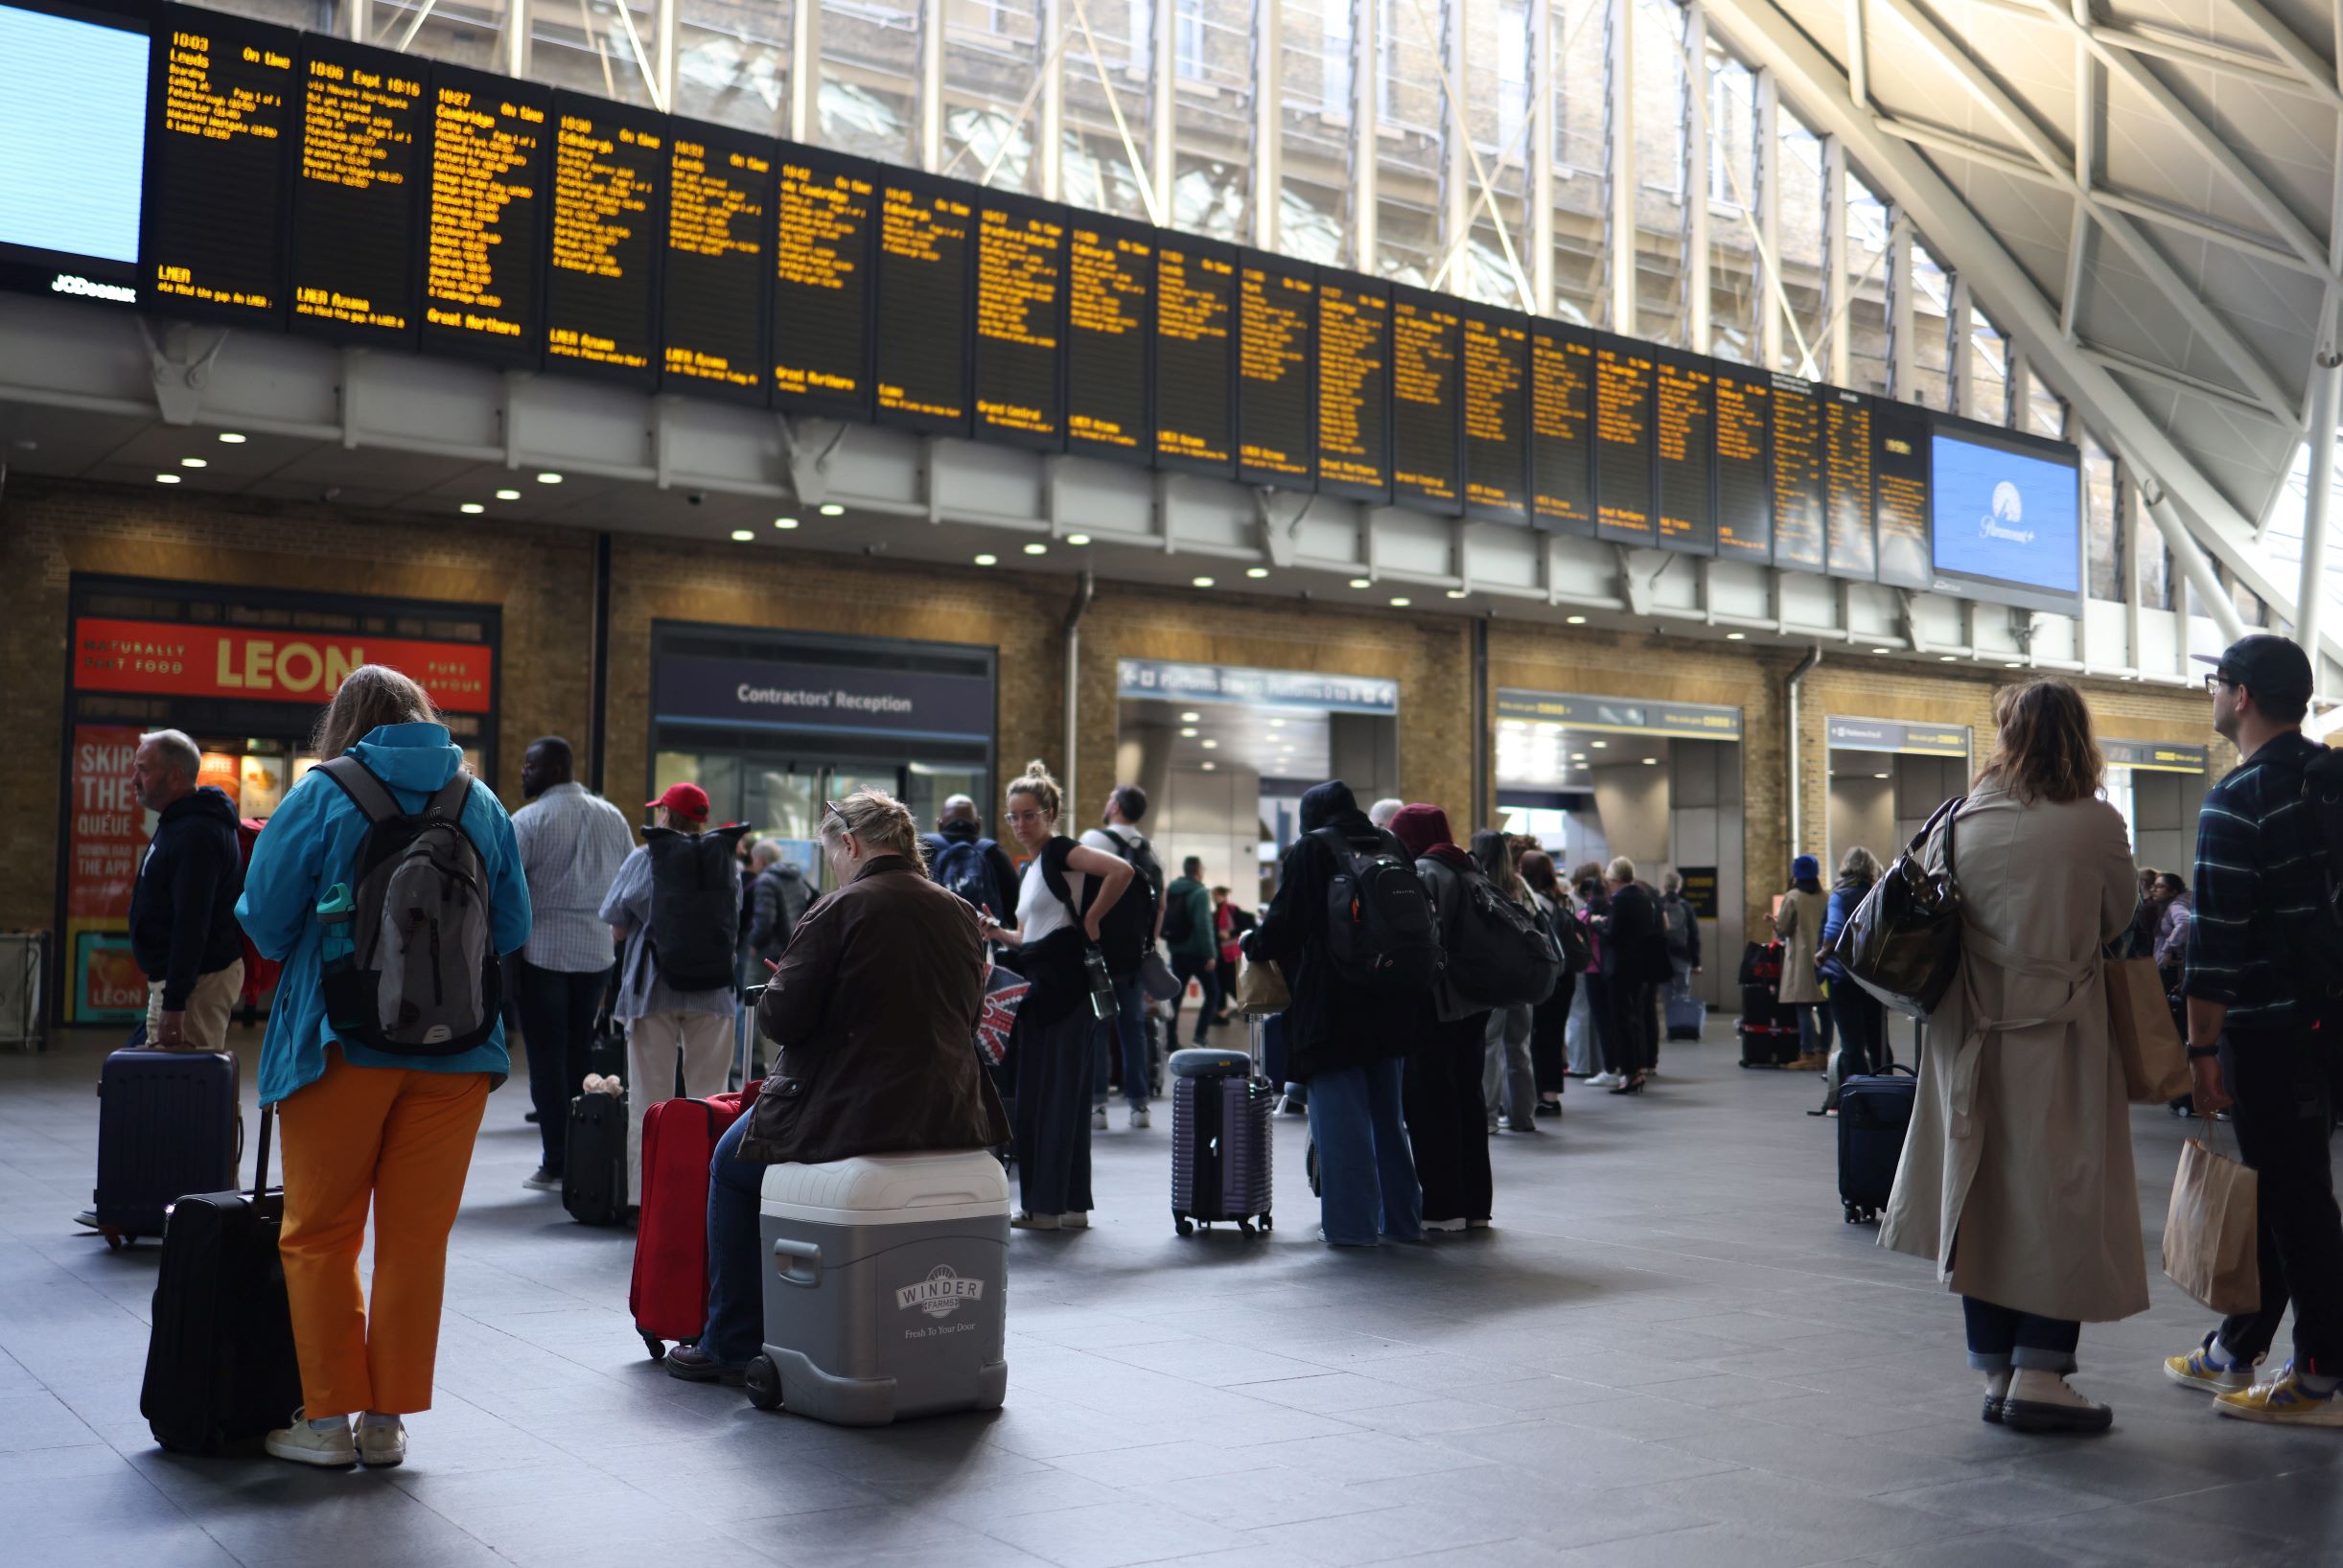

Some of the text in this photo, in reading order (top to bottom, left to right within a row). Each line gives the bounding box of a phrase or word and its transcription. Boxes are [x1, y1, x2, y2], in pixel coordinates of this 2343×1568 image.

[174, 31, 208, 52] 10:03
[170, 48, 209, 68] Leeds
[244, 47, 290, 69] On time
[311, 60, 343, 81] 10:06
[436, 104, 495, 128] Cambridge
[500, 102, 544, 123] On time
[157, 265, 191, 283] LNER
[428, 308, 521, 335] Great Northern
[84, 639, 186, 657] NATURALLY
[135, 658, 183, 675] FOOD
[217, 637, 365, 692] LEON
[429, 661, 467, 676] PURE
[1160, 674, 1218, 691] Platforms
[737, 684, 912, 713] Contractors' Reception
[81, 744, 134, 773] SKIP
[81, 777, 132, 810] THE
[78, 815, 131, 837] QUEUE
[78, 858, 128, 876] THE APP
[93, 989, 142, 1005] LEON
[903, 1281, 977, 1303] WINDER
[928, 1299, 954, 1309] FARMS
[905, 1329, 926, 1339] Fresh
[939, 1326, 955, 1334] Your
[957, 1323, 976, 1331] Door
